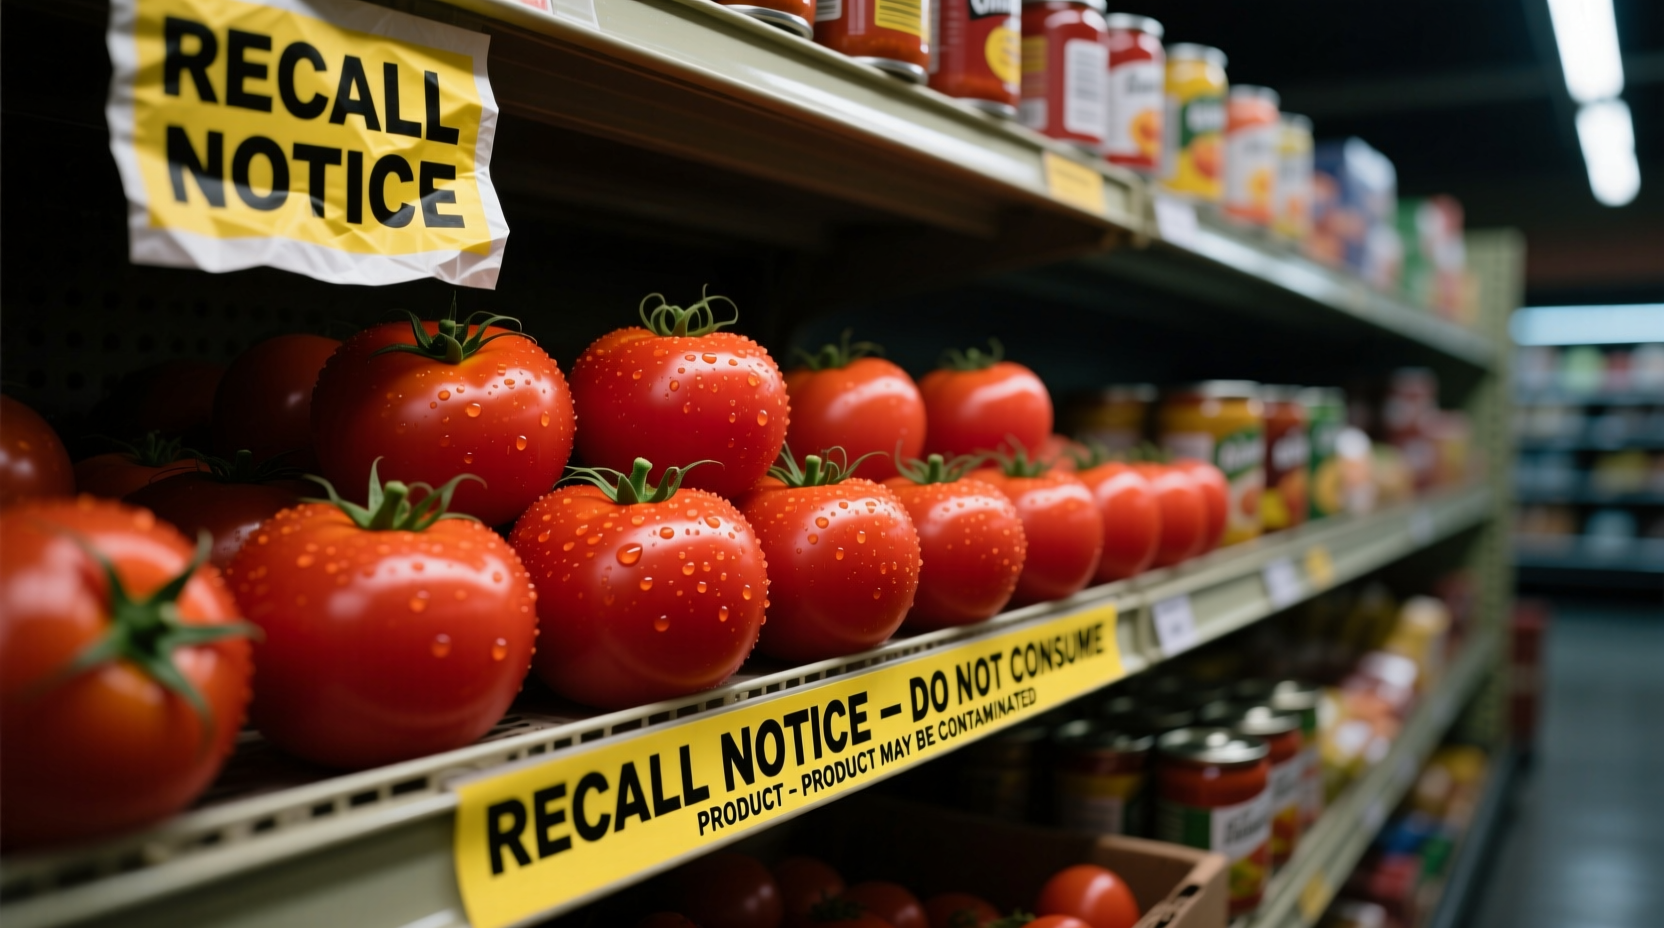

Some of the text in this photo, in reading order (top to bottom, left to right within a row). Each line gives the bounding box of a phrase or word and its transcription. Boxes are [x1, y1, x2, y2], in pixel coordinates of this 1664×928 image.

[163, 14, 461, 146] RECALL
[164, 125, 467, 229] NOTICE
[484, 744, 711, 877] RECALL
[720, 690, 873, 793] NOTICE
[909, 670, 949, 723] DO
[955, 653, 1004, 706] NOT
[1009, 623, 1106, 684] CONSUME
[697, 782, 784, 837] PRODUCT
[801, 748, 876, 797] PRODUCT
[879, 734, 912, 766] MAY
[915, 725, 936, 751] BE
[938, 687, 1036, 740] CONTAMINATED
